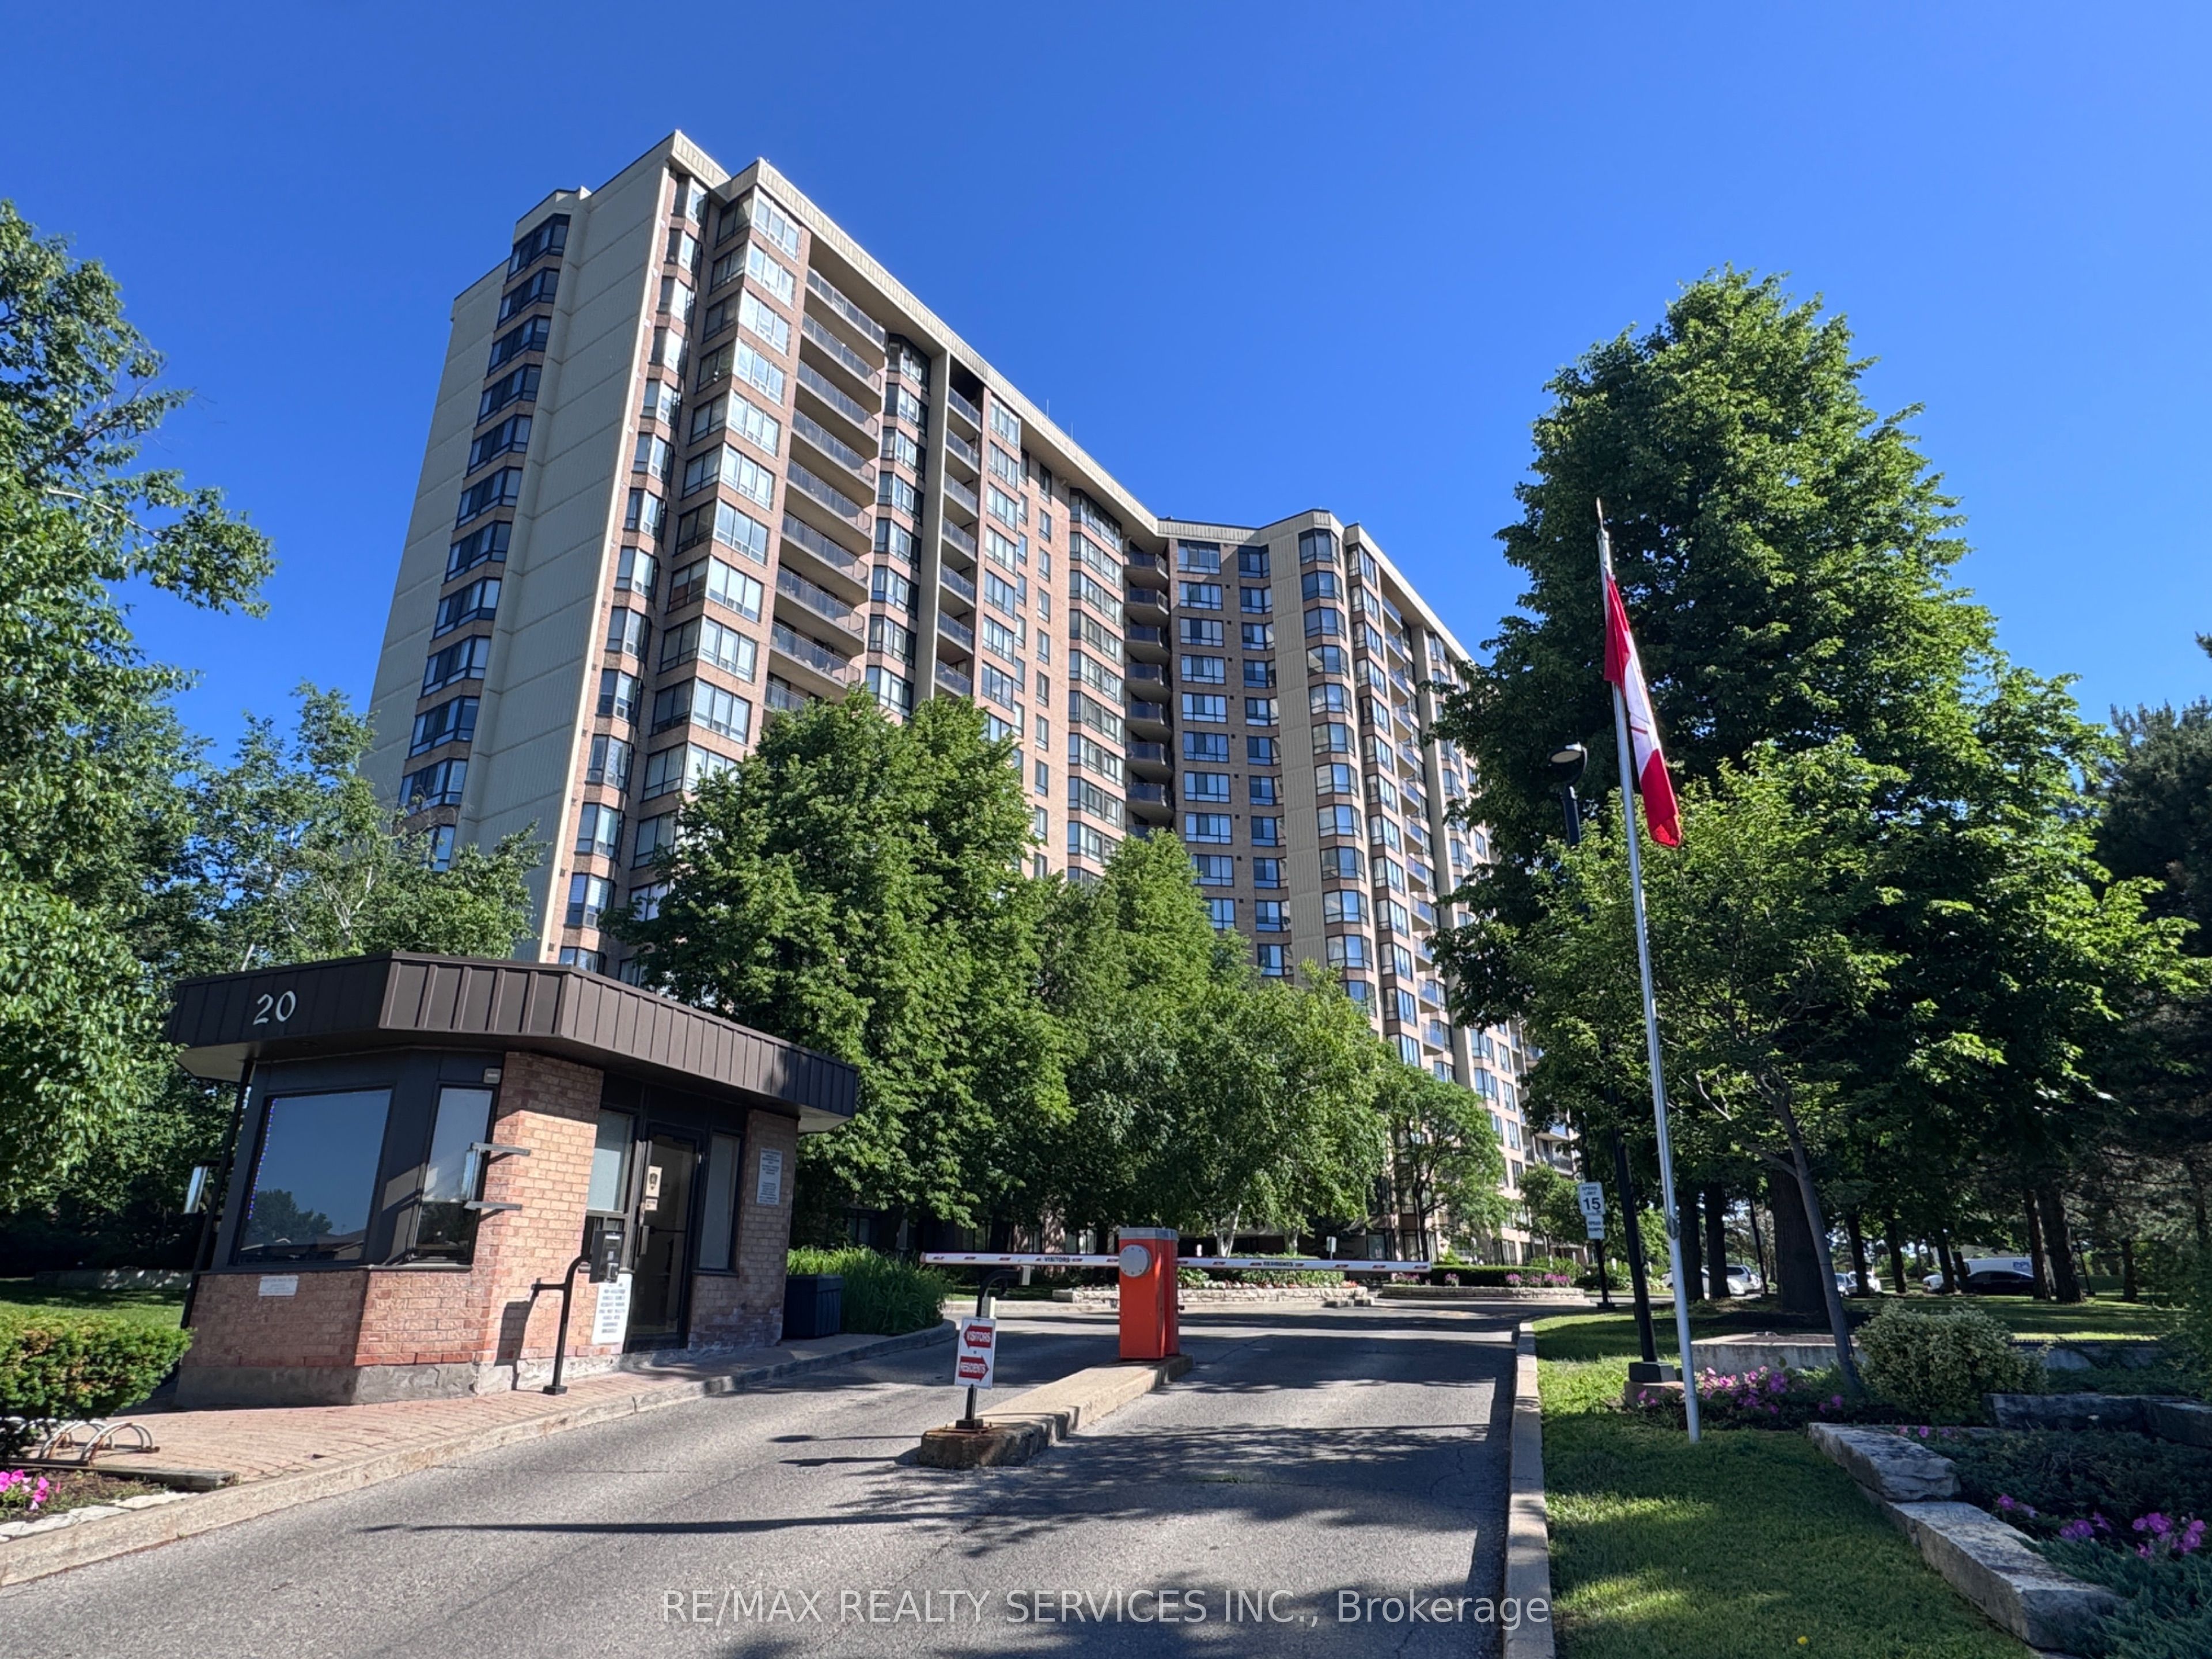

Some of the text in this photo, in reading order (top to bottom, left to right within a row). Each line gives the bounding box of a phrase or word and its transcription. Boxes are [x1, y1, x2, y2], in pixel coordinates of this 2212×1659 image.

[253, 990, 296, 1025] 20
[1583, 1197, 1601, 1210] 15
[967, 1330, 991, 1343] VISITORS
[960, 1362, 986, 1375] RESIDENTS
